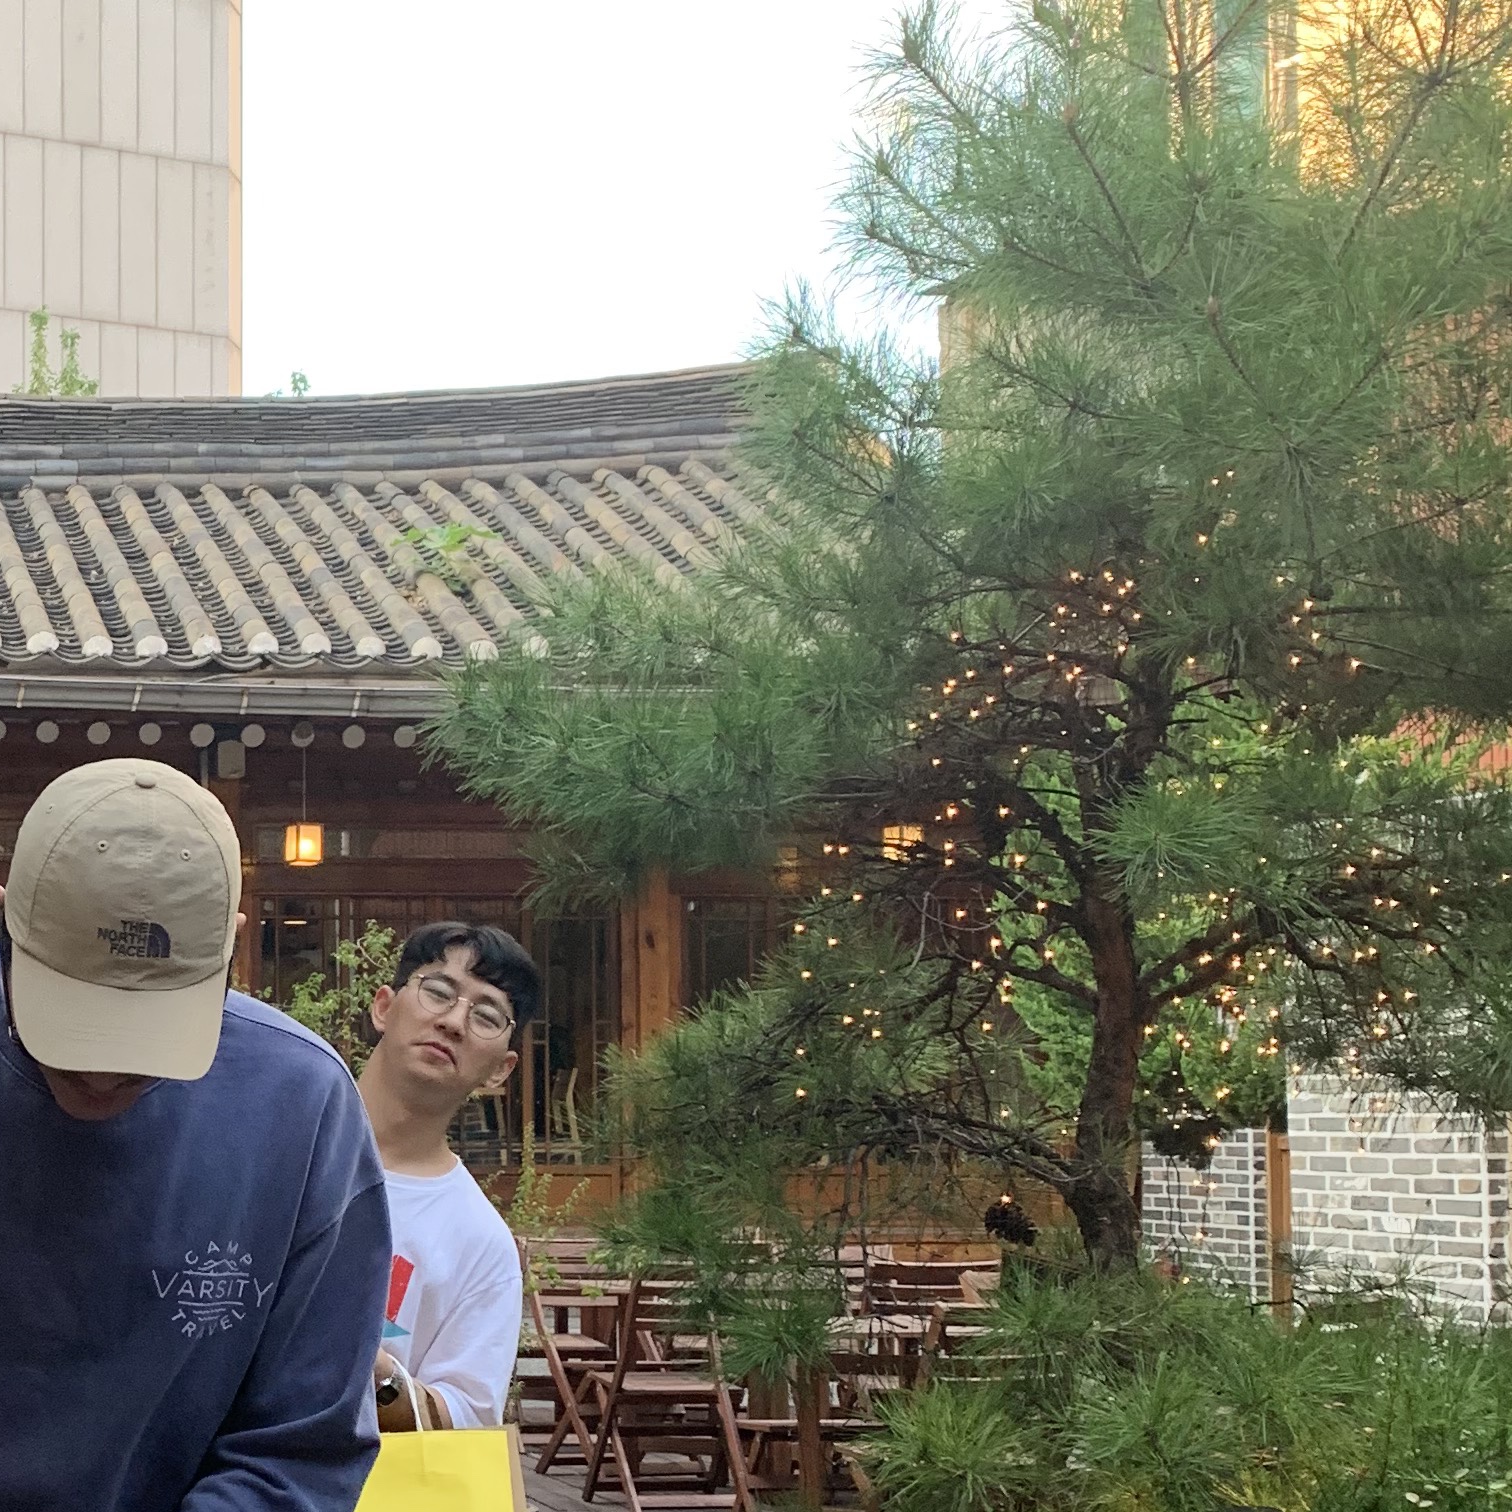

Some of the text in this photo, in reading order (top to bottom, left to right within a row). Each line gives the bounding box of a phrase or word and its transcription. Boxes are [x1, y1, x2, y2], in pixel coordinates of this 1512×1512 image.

[121, 920, 149, 933] THE
[97, 927, 147, 944] NORTH
[110, 943, 145, 957] FACE
[184, 1240, 253, 1265] CAMP
[152, 1269, 273, 1308] VARSITY
